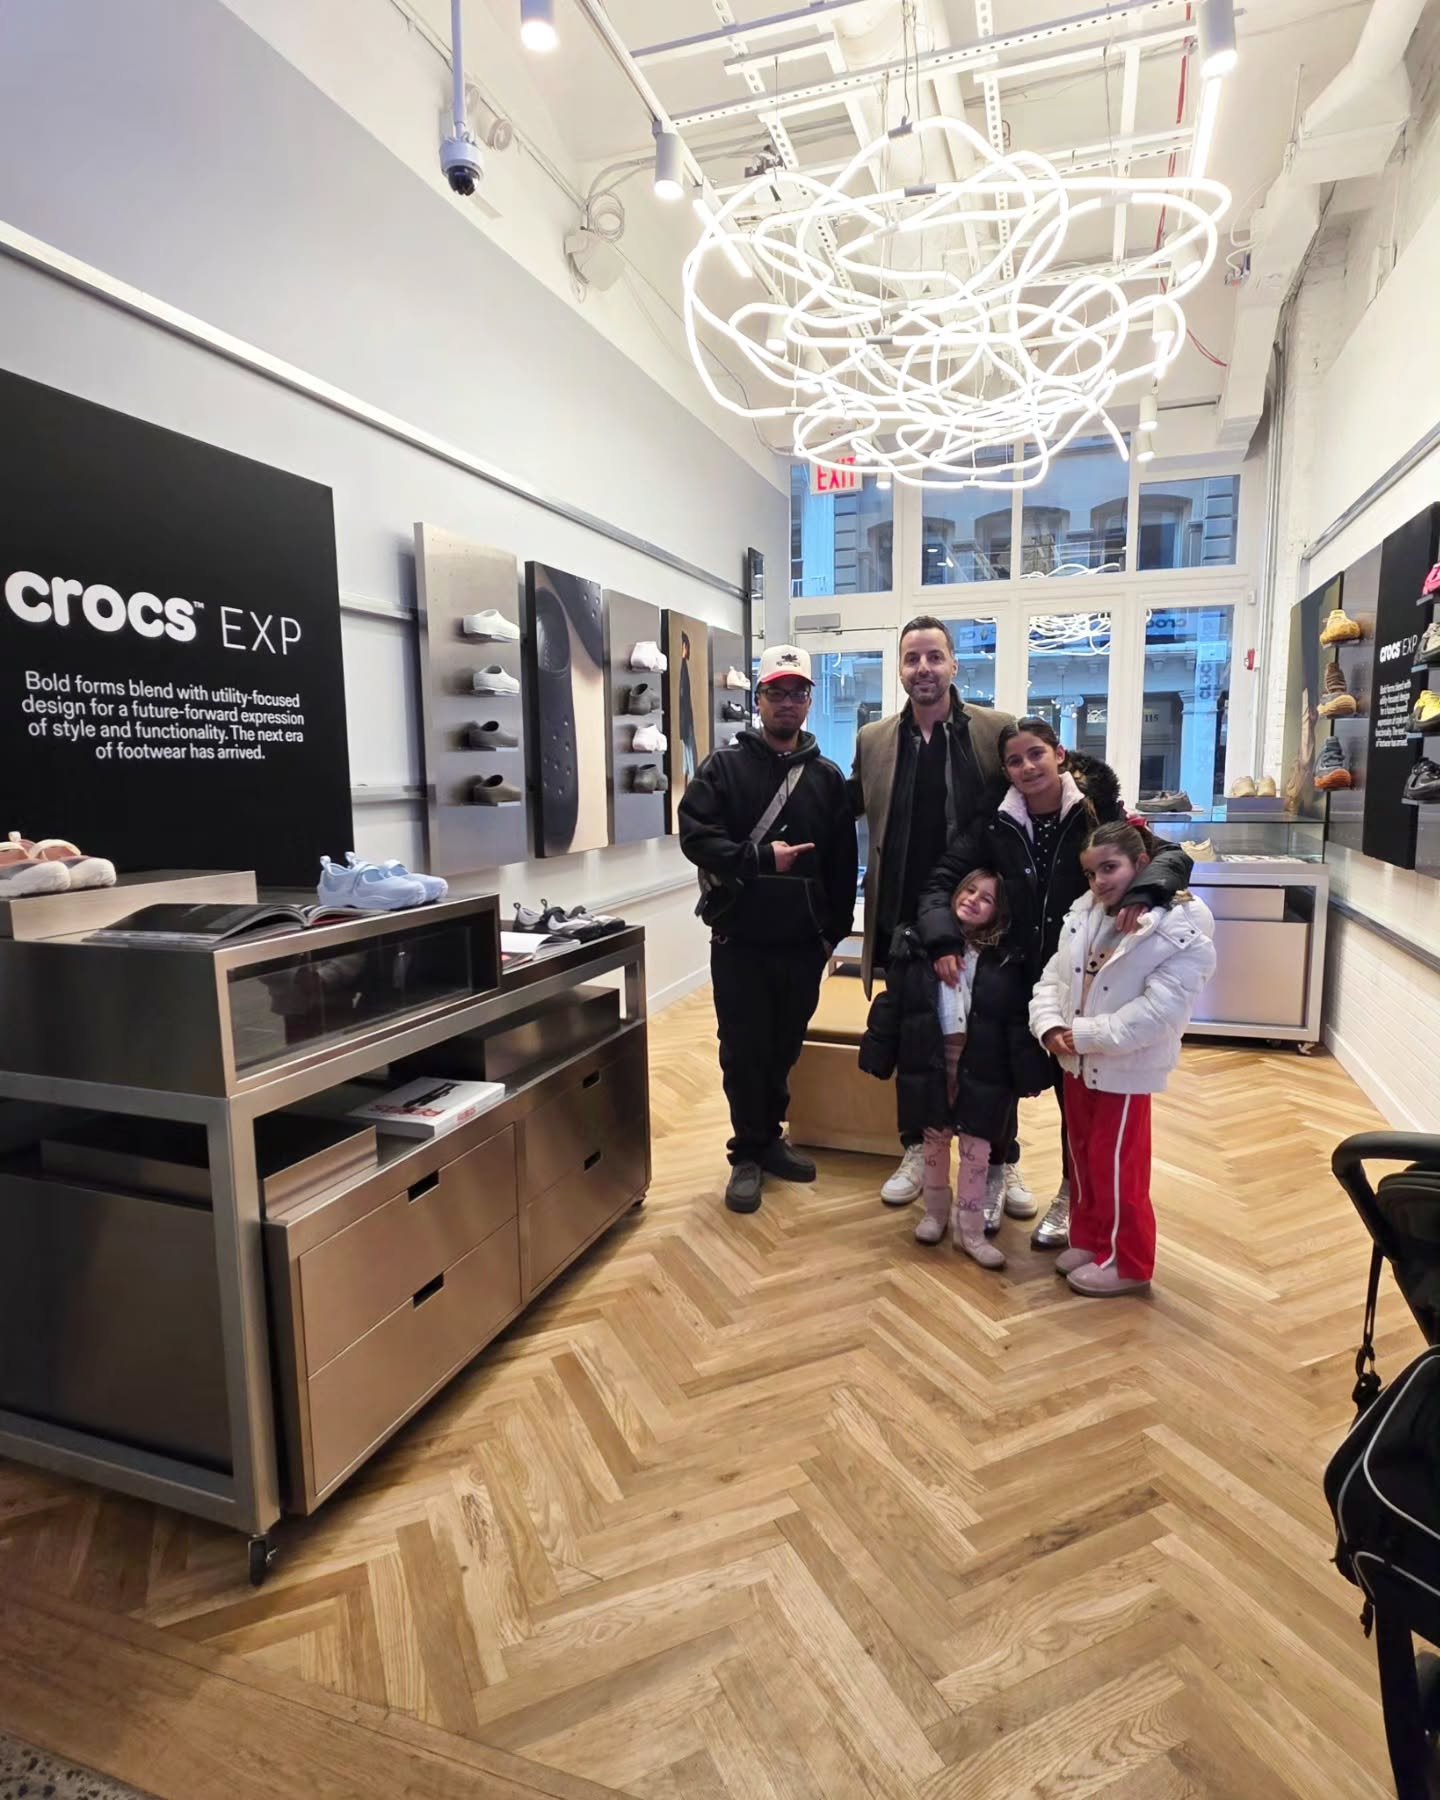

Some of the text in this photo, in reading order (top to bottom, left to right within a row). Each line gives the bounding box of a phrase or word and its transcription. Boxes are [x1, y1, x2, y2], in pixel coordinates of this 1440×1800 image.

[817, 456, 857, 491] EXIT
[5, 571, 197, 642] crocs
[220, 606, 301, 655] EXP
[1402, 634, 1418, 656] EXP
[25, 670, 300, 708] Bold forms blend with utility-focused
[21, 694, 304, 727] design for a future-forward expression
[28, 717, 304, 744] of style and functionality. The next era
[95, 741, 266, 760] of footwear has arrived.
